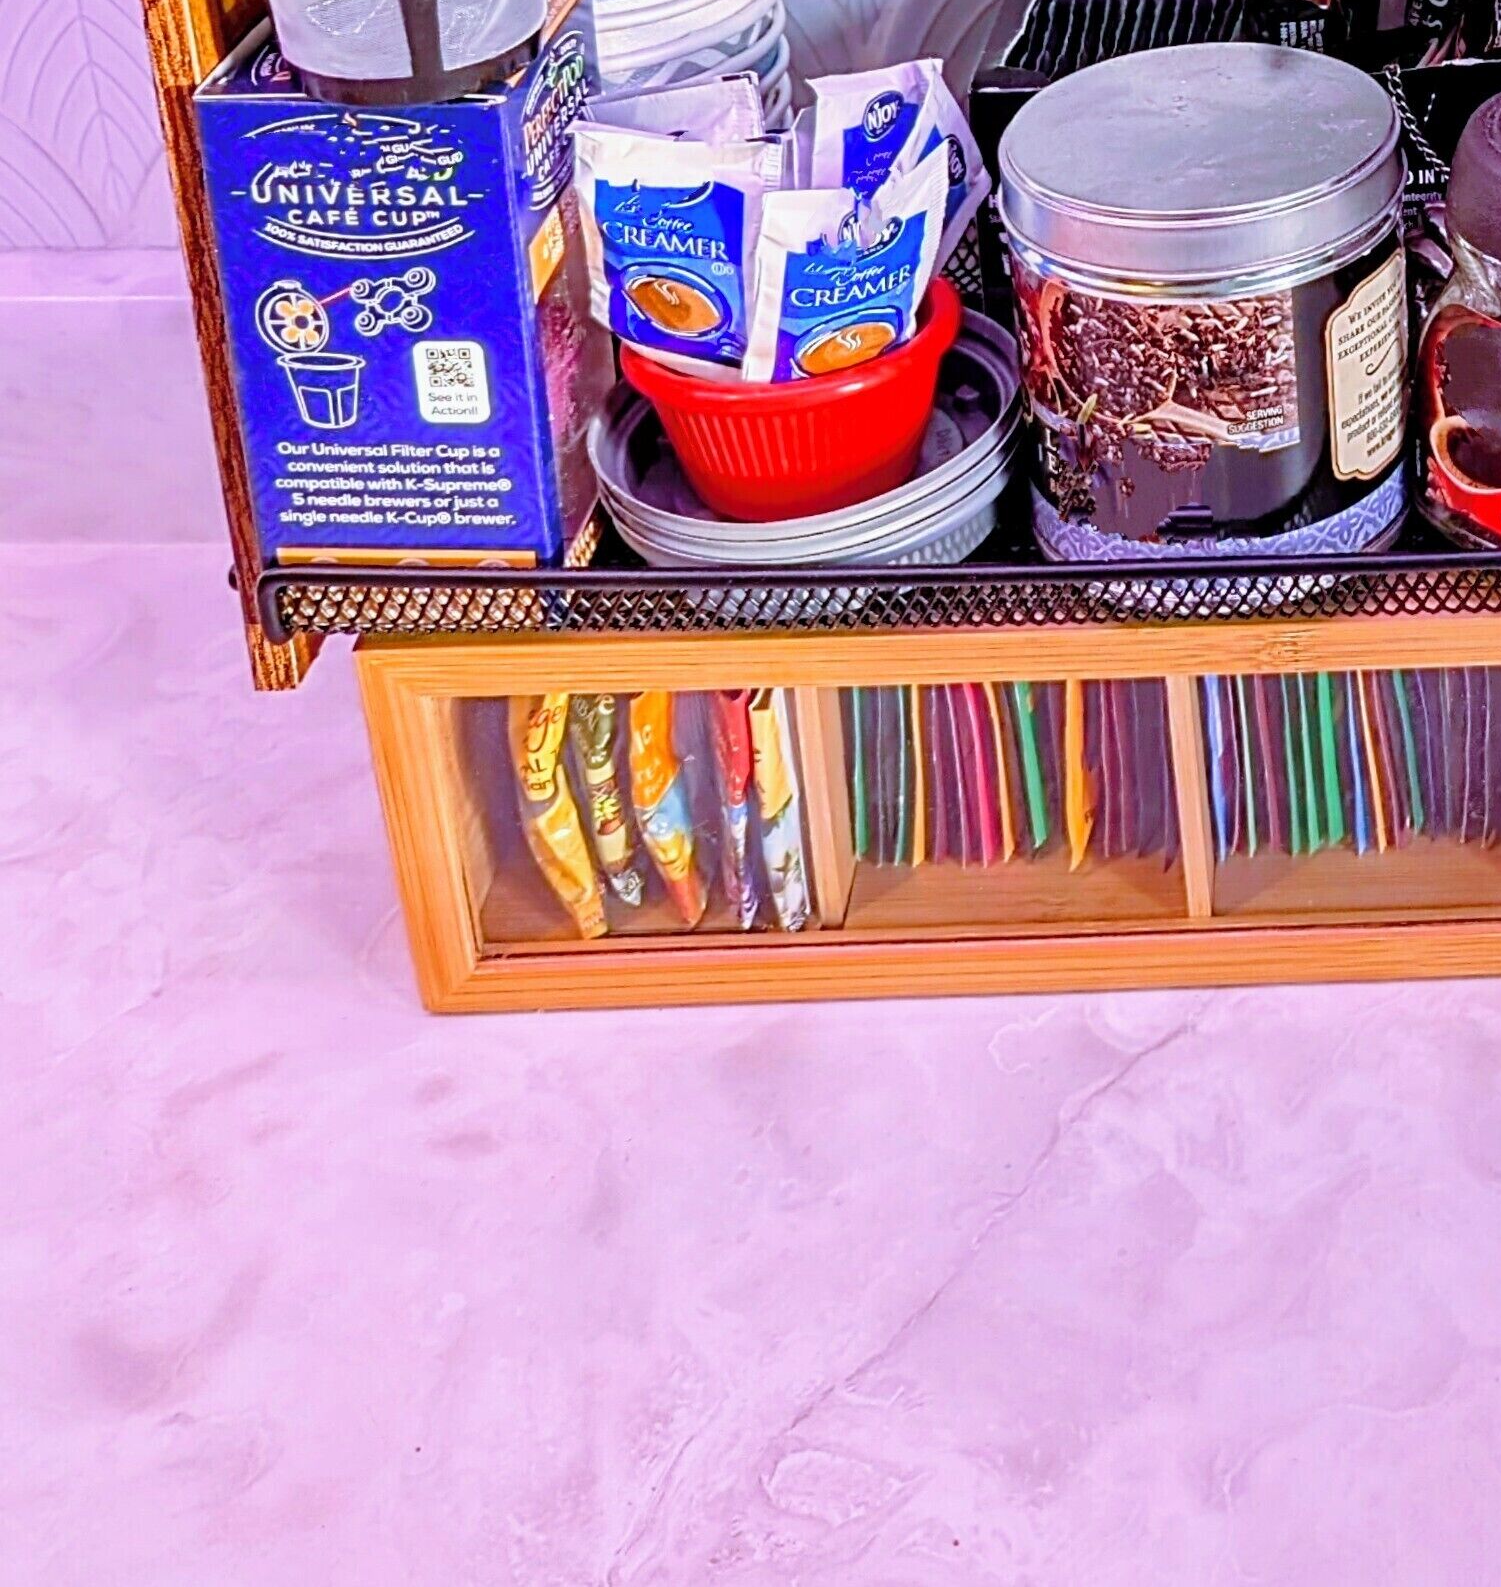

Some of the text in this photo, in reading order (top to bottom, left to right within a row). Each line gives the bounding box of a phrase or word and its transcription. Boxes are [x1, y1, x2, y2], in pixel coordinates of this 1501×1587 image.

[251, 184, 468, 207] UNIVERSAL
[288, 207, 359, 226] CAFÉ
[264, 223, 464, 253] 100% SATISFACTION GUARANTEED
[603, 220, 729, 261] CREAMER
[790, 264, 911, 307] CREAMER
[1348, 310, 1362, 325] WE
[1363, 293, 1387, 317] INVITE
[1338, 313, 1381, 346] SHARE OUR
[1337, 320, 1388, 361] EXCEPTIONAL
[428, 392, 478, 403] See it in
[1246, 405, 1283, 421] SERVING
[1228, 416, 1284, 434] SUGGESTION
[277, 442, 501, 461] Our Universal Filter Cup is a
[287, 461, 495, 475] convenient solution that is
[275, 478, 512, 496] compatible with K-Supreme®
[292, 493, 499, 511] 5 needle brewers or just a
[280, 509, 517, 527] single needle K-Cup® brewer.
